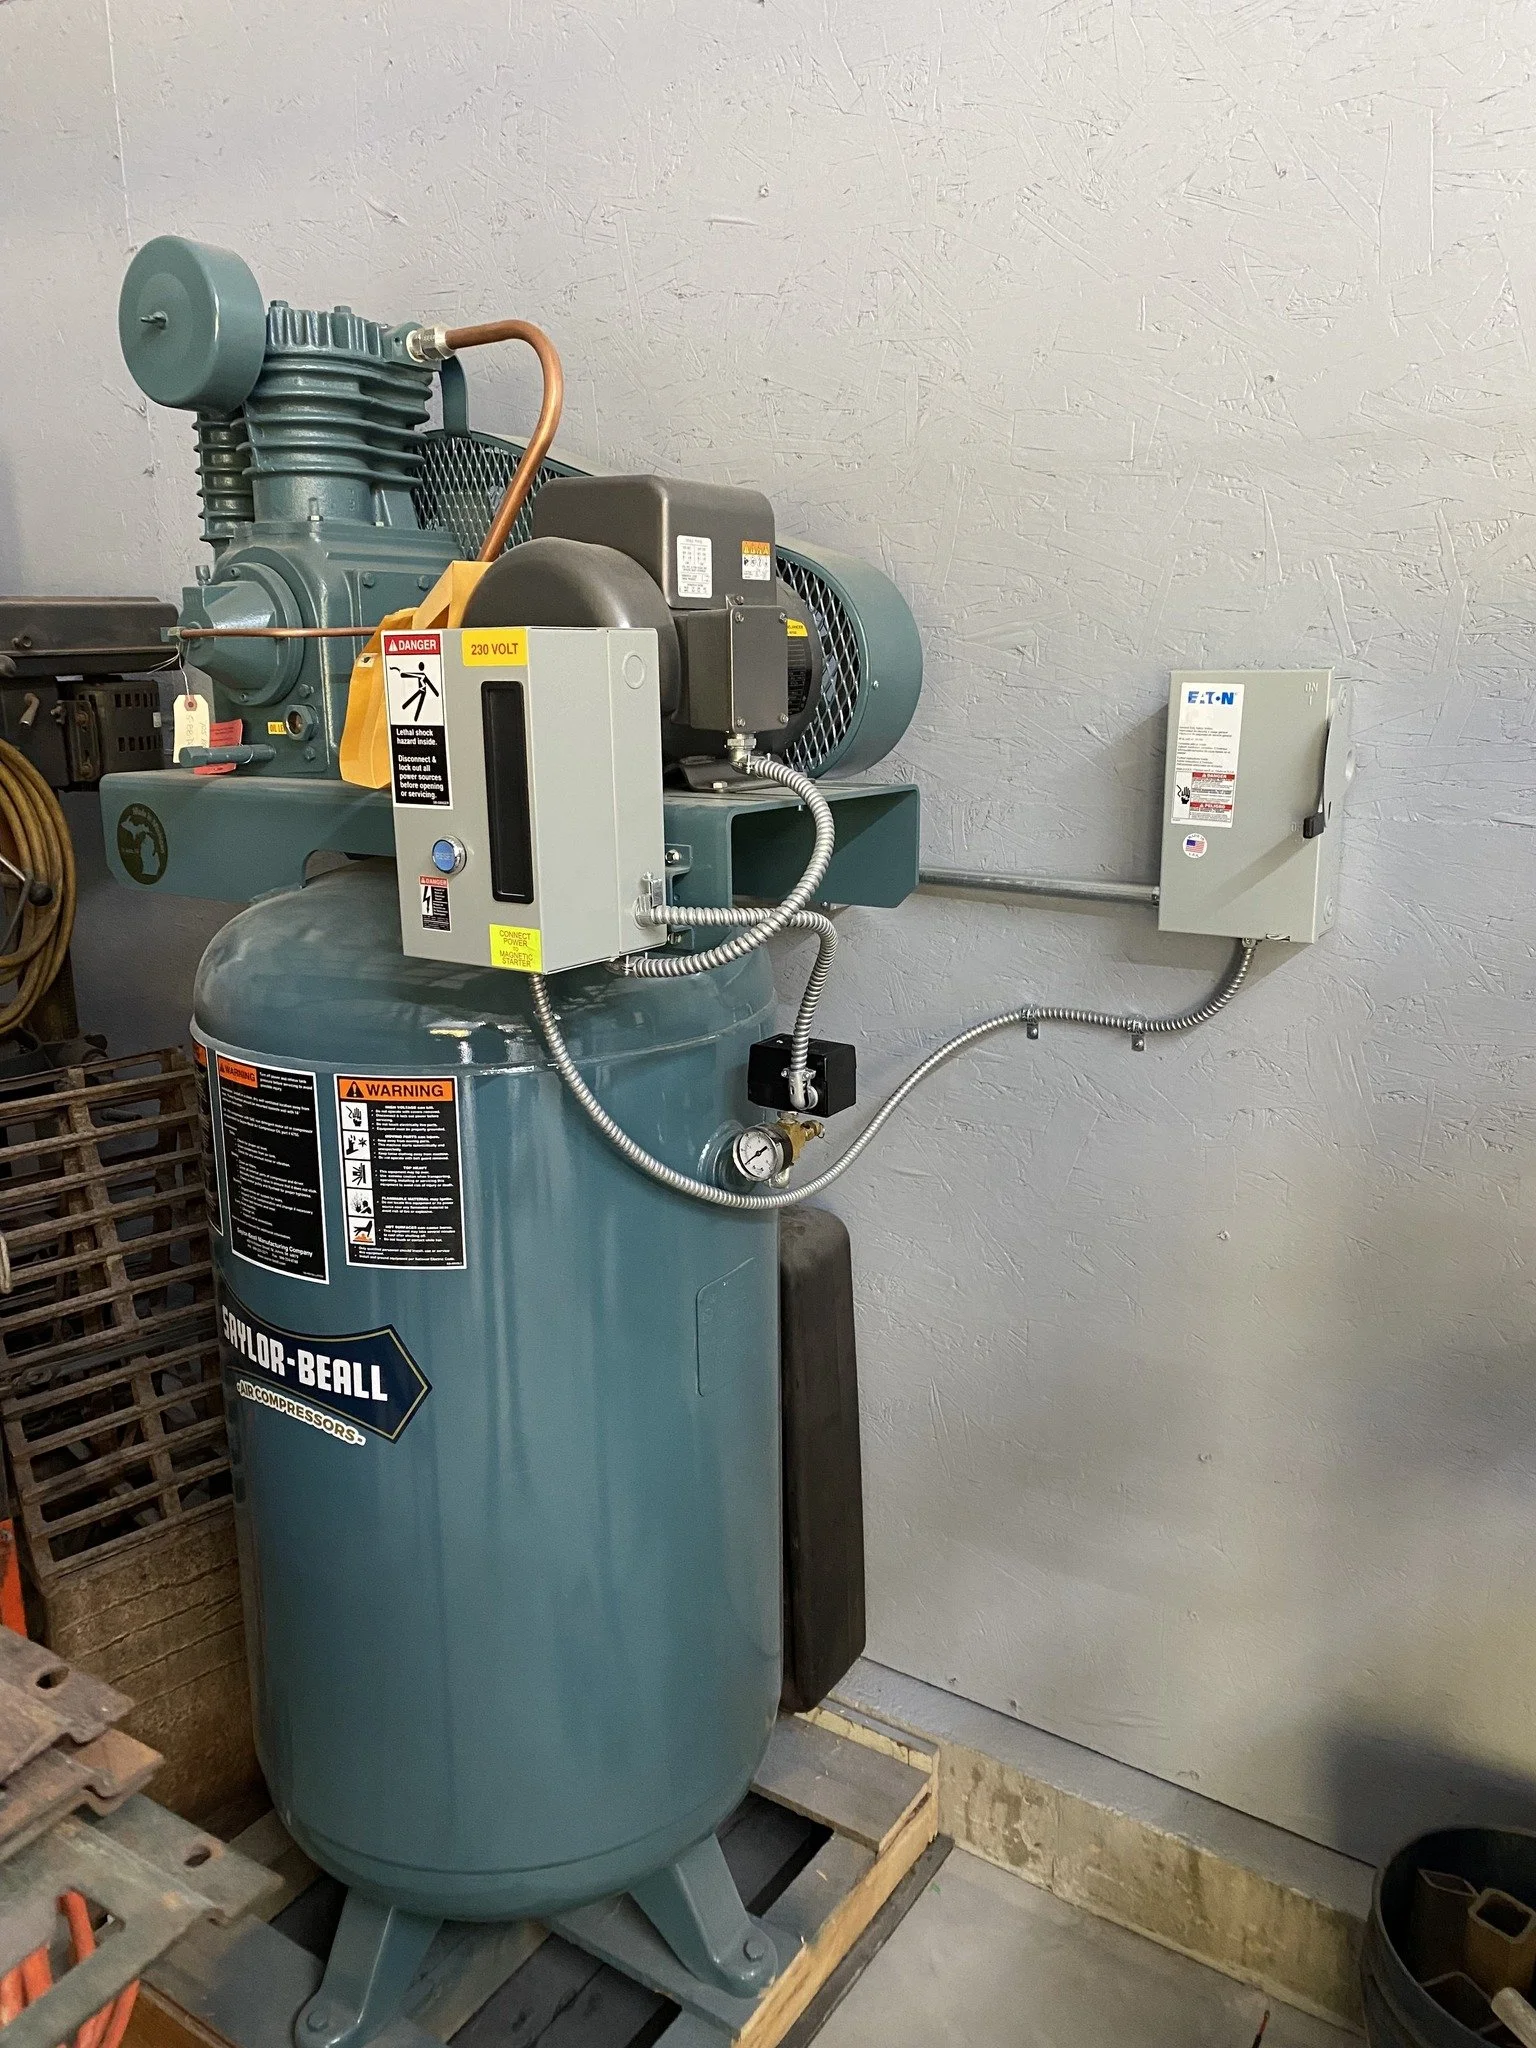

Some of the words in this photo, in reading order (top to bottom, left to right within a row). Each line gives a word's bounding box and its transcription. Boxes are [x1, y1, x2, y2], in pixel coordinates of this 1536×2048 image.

[398, 640, 436, 650] DANGER
[471, 644, 489, 656] 230
[491, 643, 518, 654] VOLT
[1305, 682, 1318, 692] ON
[270, 724, 278, 732] OIL
[398, 755, 430, 763] Disconnect
[420, 782, 444, 791] opening
[408, 791, 437, 800] servicing.
[499, 930, 531, 940] CONNECT
[503, 938, 527, 947] POWER
[500, 950, 533, 961] MAGNETIC
[502, 957, 531, 967] STARTER
[225, 1066, 255, 1081] WARNING
[366, 1084, 443, 1097] WARNING
[289, 1246, 312, 1258] Company
[222, 1304, 388, 1402] SAYLOR-BEALL
